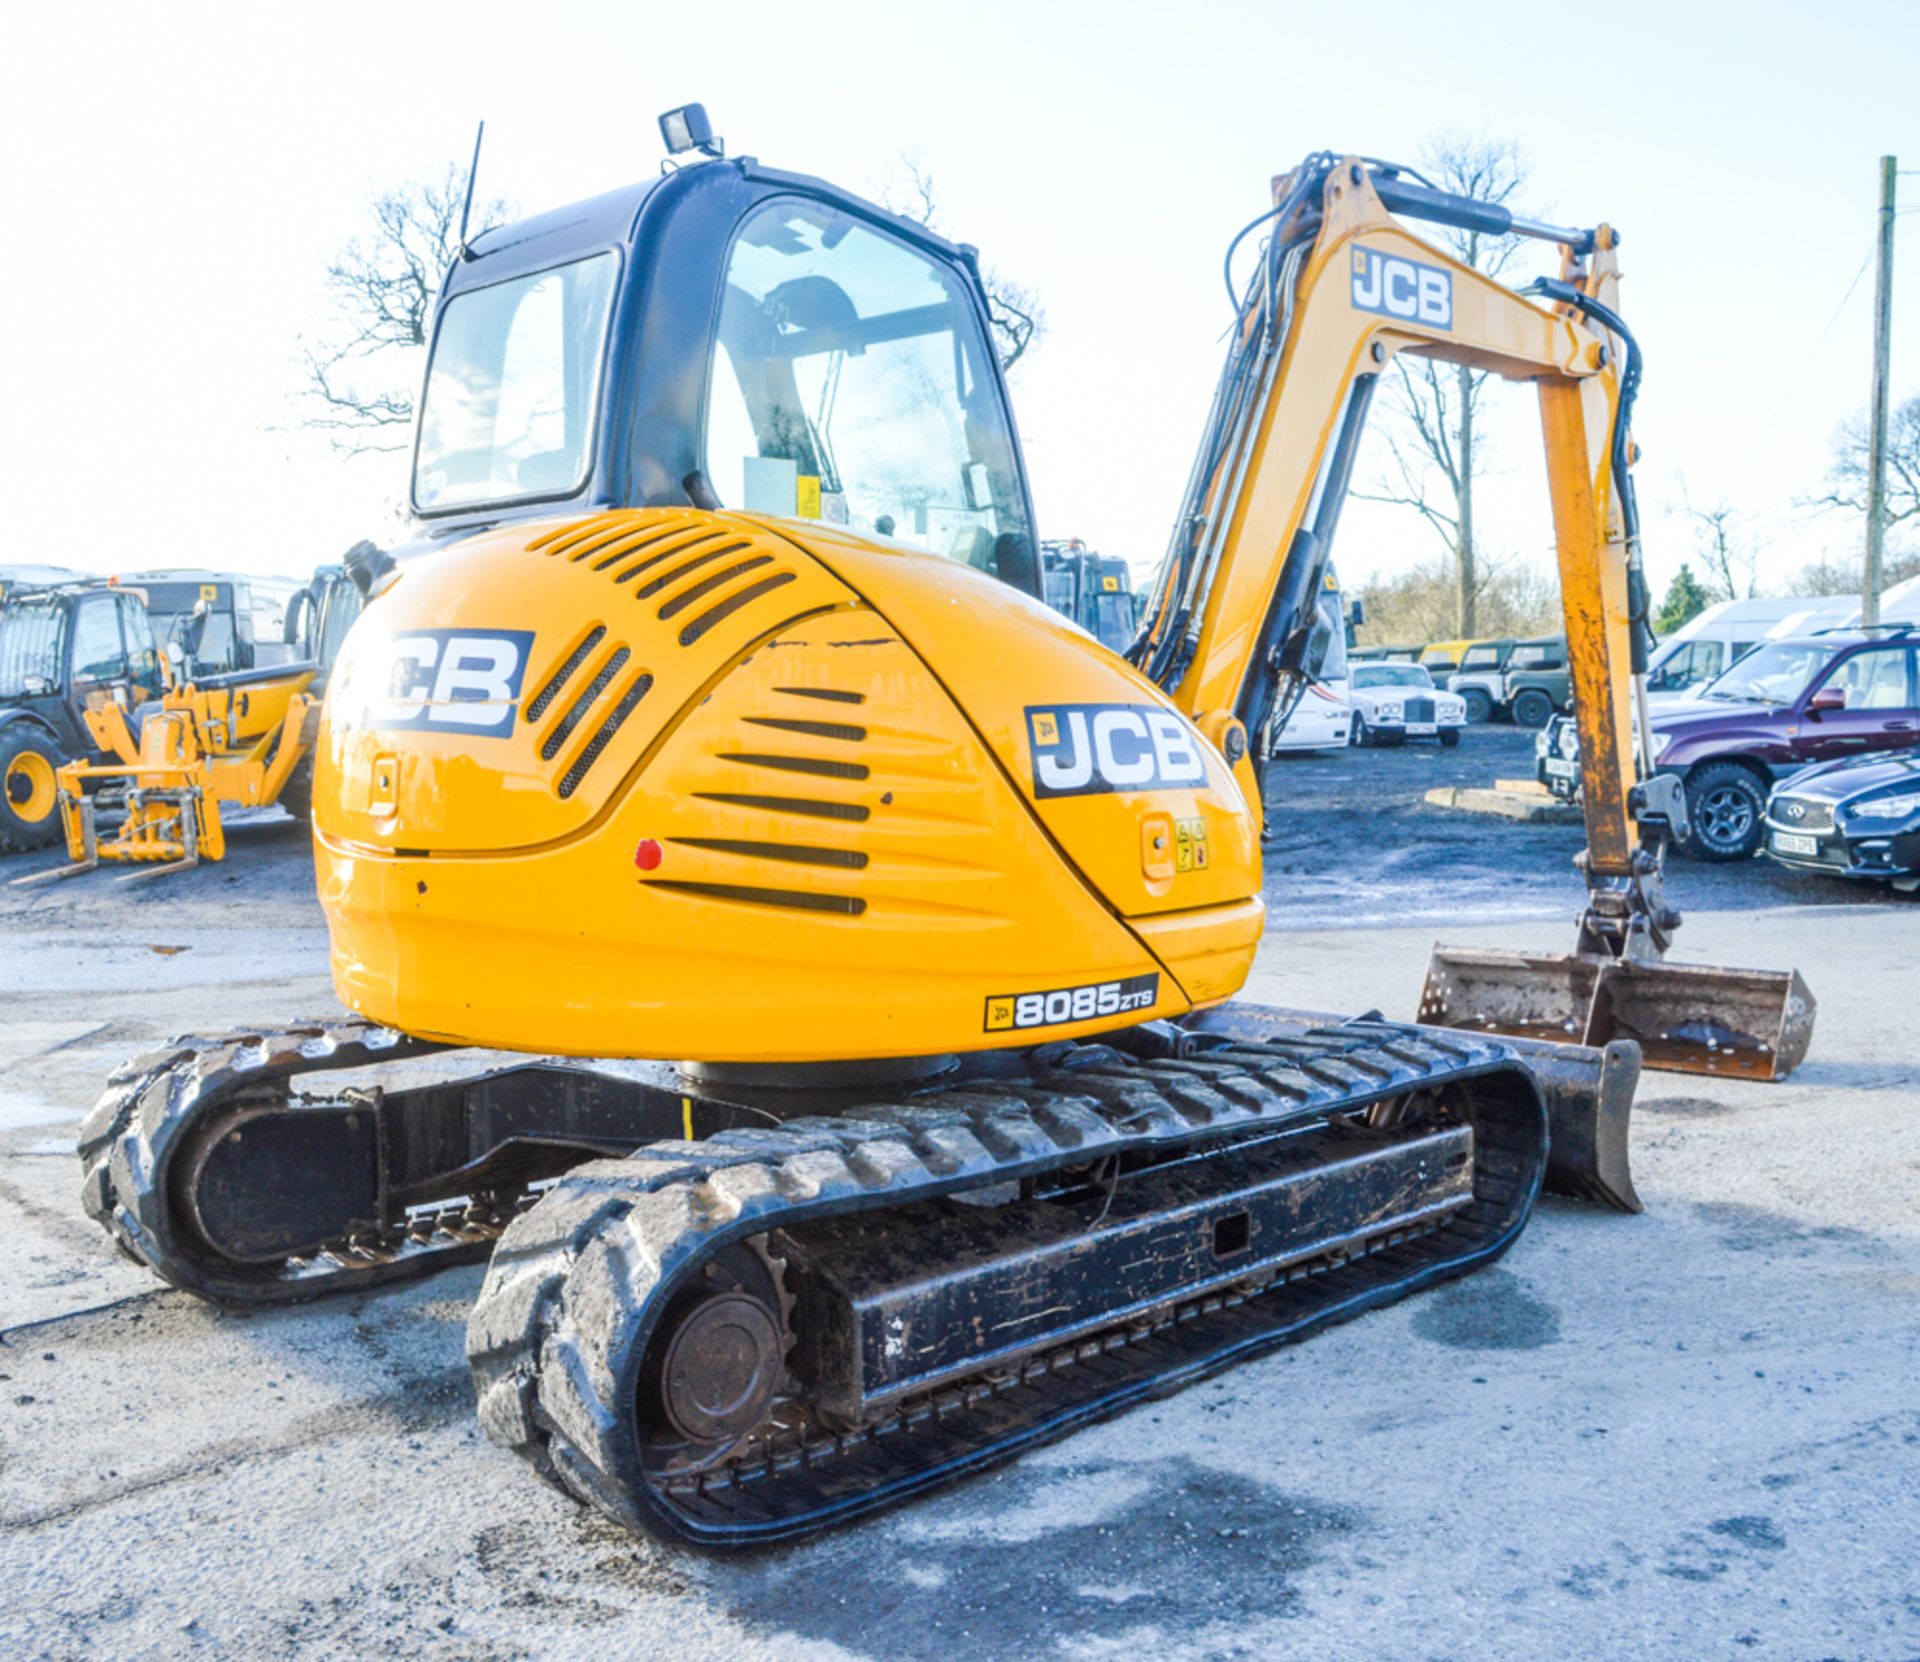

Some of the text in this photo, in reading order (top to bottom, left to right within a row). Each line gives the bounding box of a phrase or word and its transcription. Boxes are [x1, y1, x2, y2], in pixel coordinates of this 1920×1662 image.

[1353, 254, 1450, 325] JCB
[366, 636, 519, 727] CB
[1037, 710, 1203, 790] JCB
